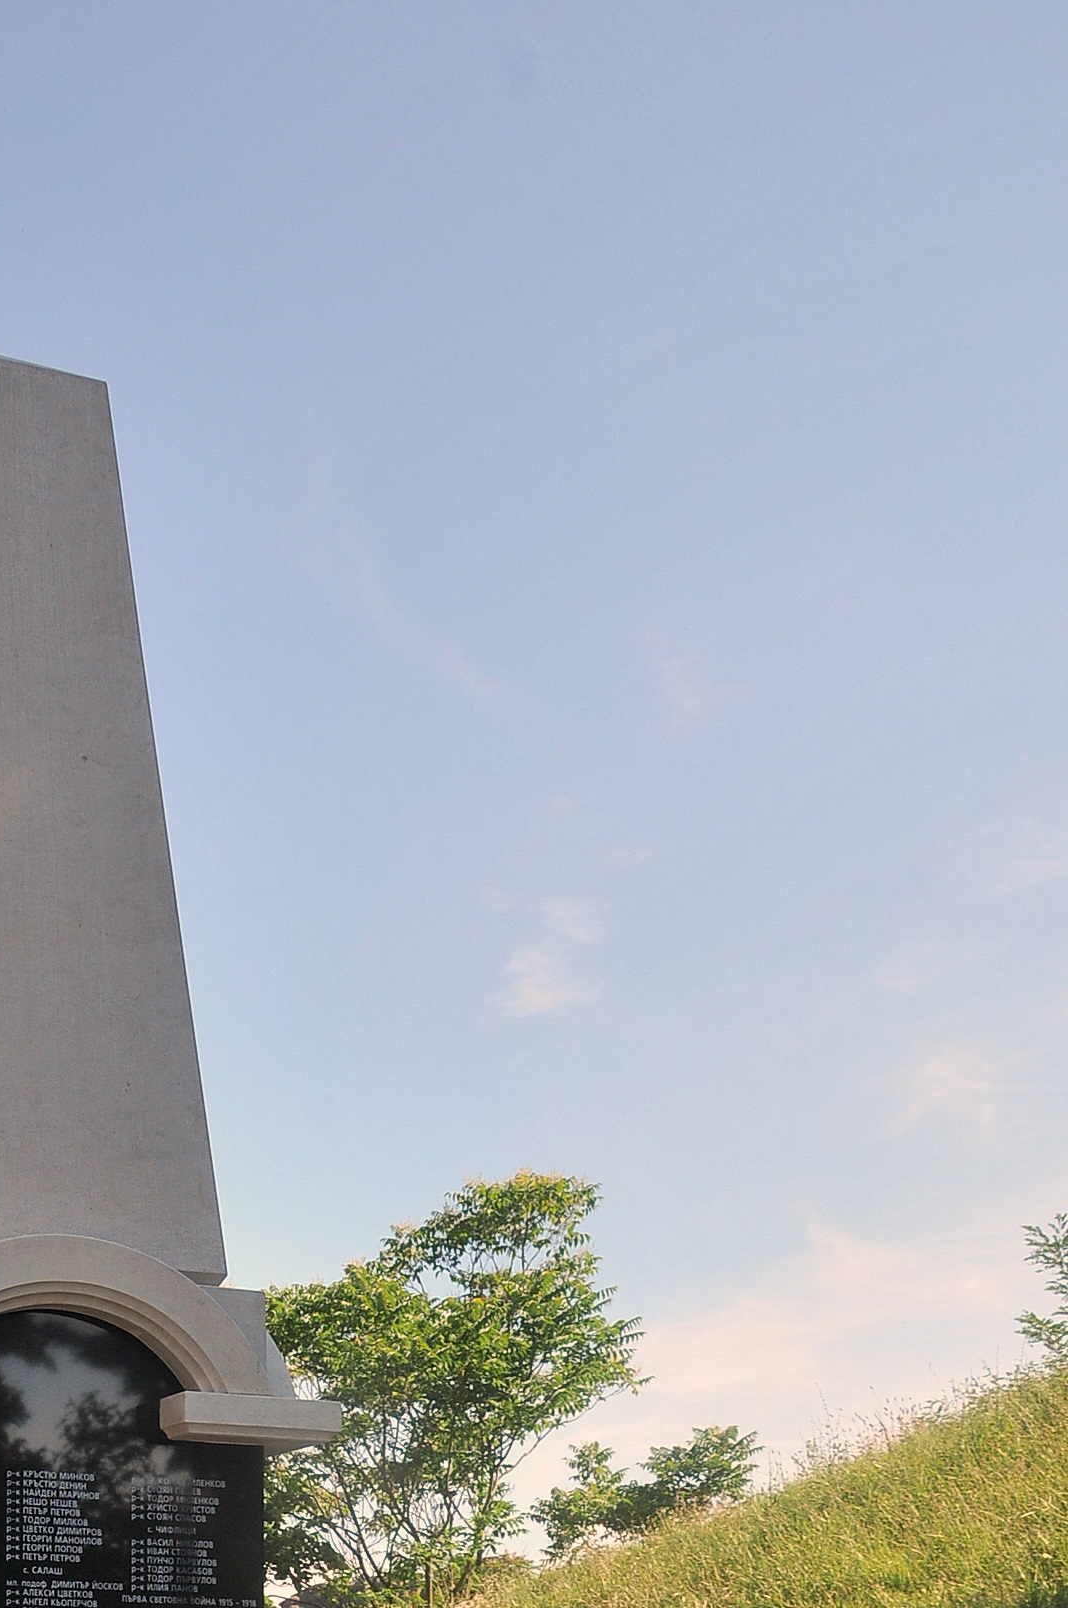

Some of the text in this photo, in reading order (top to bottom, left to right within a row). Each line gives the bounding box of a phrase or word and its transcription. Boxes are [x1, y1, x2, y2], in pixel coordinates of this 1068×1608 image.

[6, 1470, 20, 1478] р-к
[6, 1516, 20, 1524] р-к
[6, 1525, 20, 1533] р-к
[6, 1543, 20, 1552] р-к
